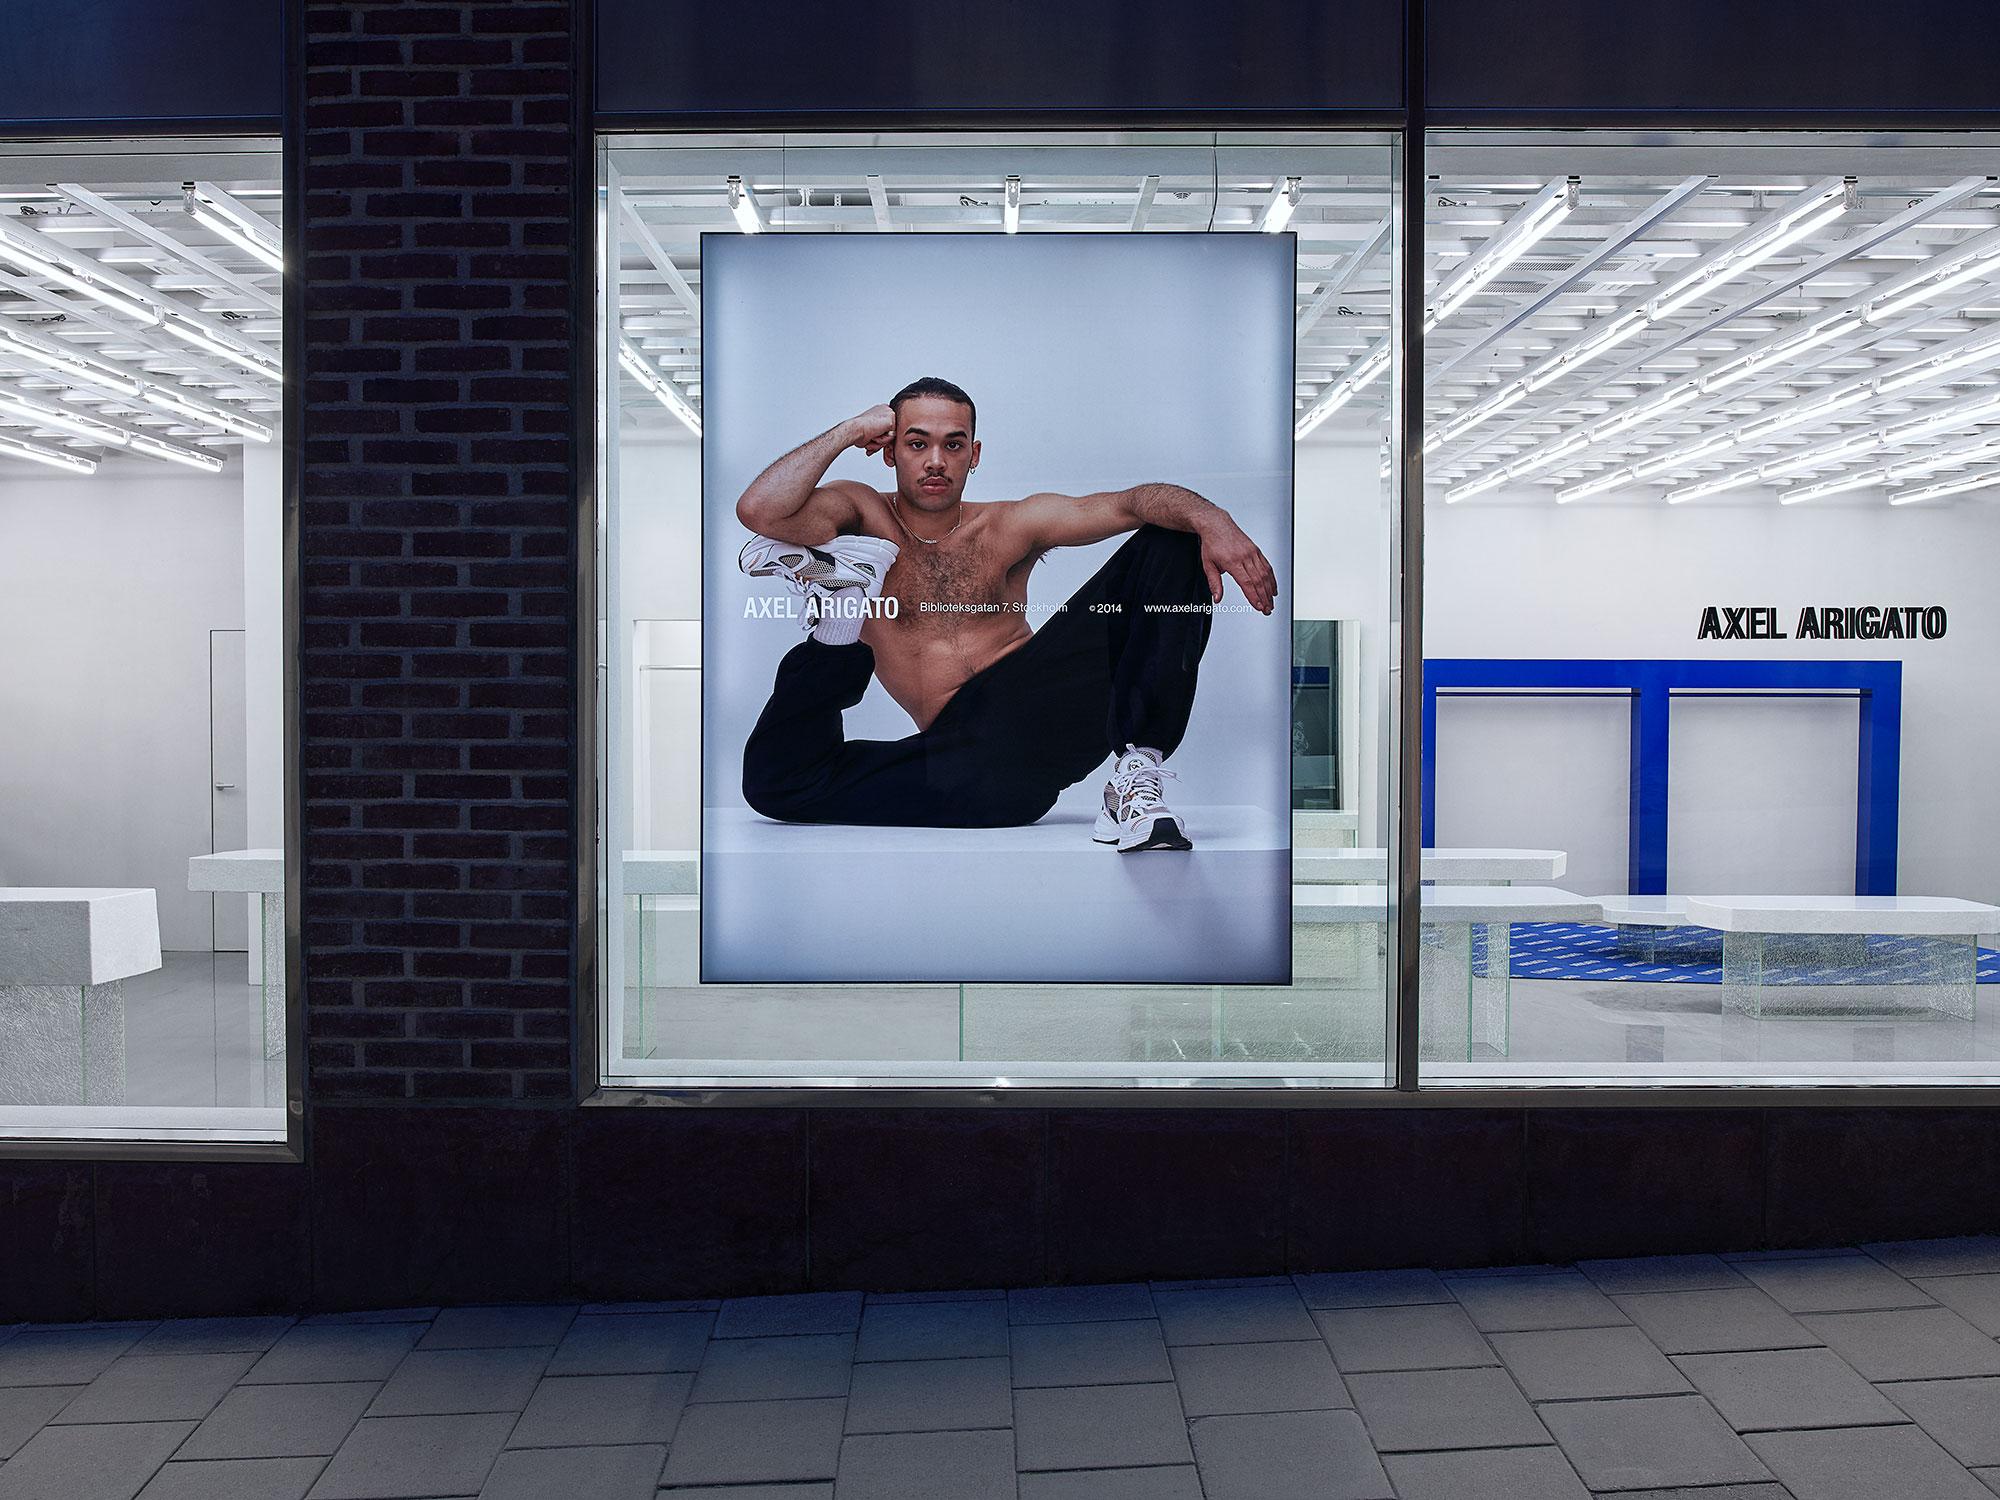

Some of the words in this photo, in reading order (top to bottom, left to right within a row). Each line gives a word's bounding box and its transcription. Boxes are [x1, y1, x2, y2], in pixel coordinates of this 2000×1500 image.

[743, 596, 798, 619] AXEL
[805, 596, 899, 619] ARIGATO
[920, 602, 1000, 614] Biblioteksgatan
[1002, 602, 1010, 613] 7,
[1012, 602, 1068, 613] Stockholm
[1144, 602, 1253, 614] www.axelarigato.com
[1698, 606, 1787, 640] AXEL
[1796, 606, 1948, 640] ARIGATO
